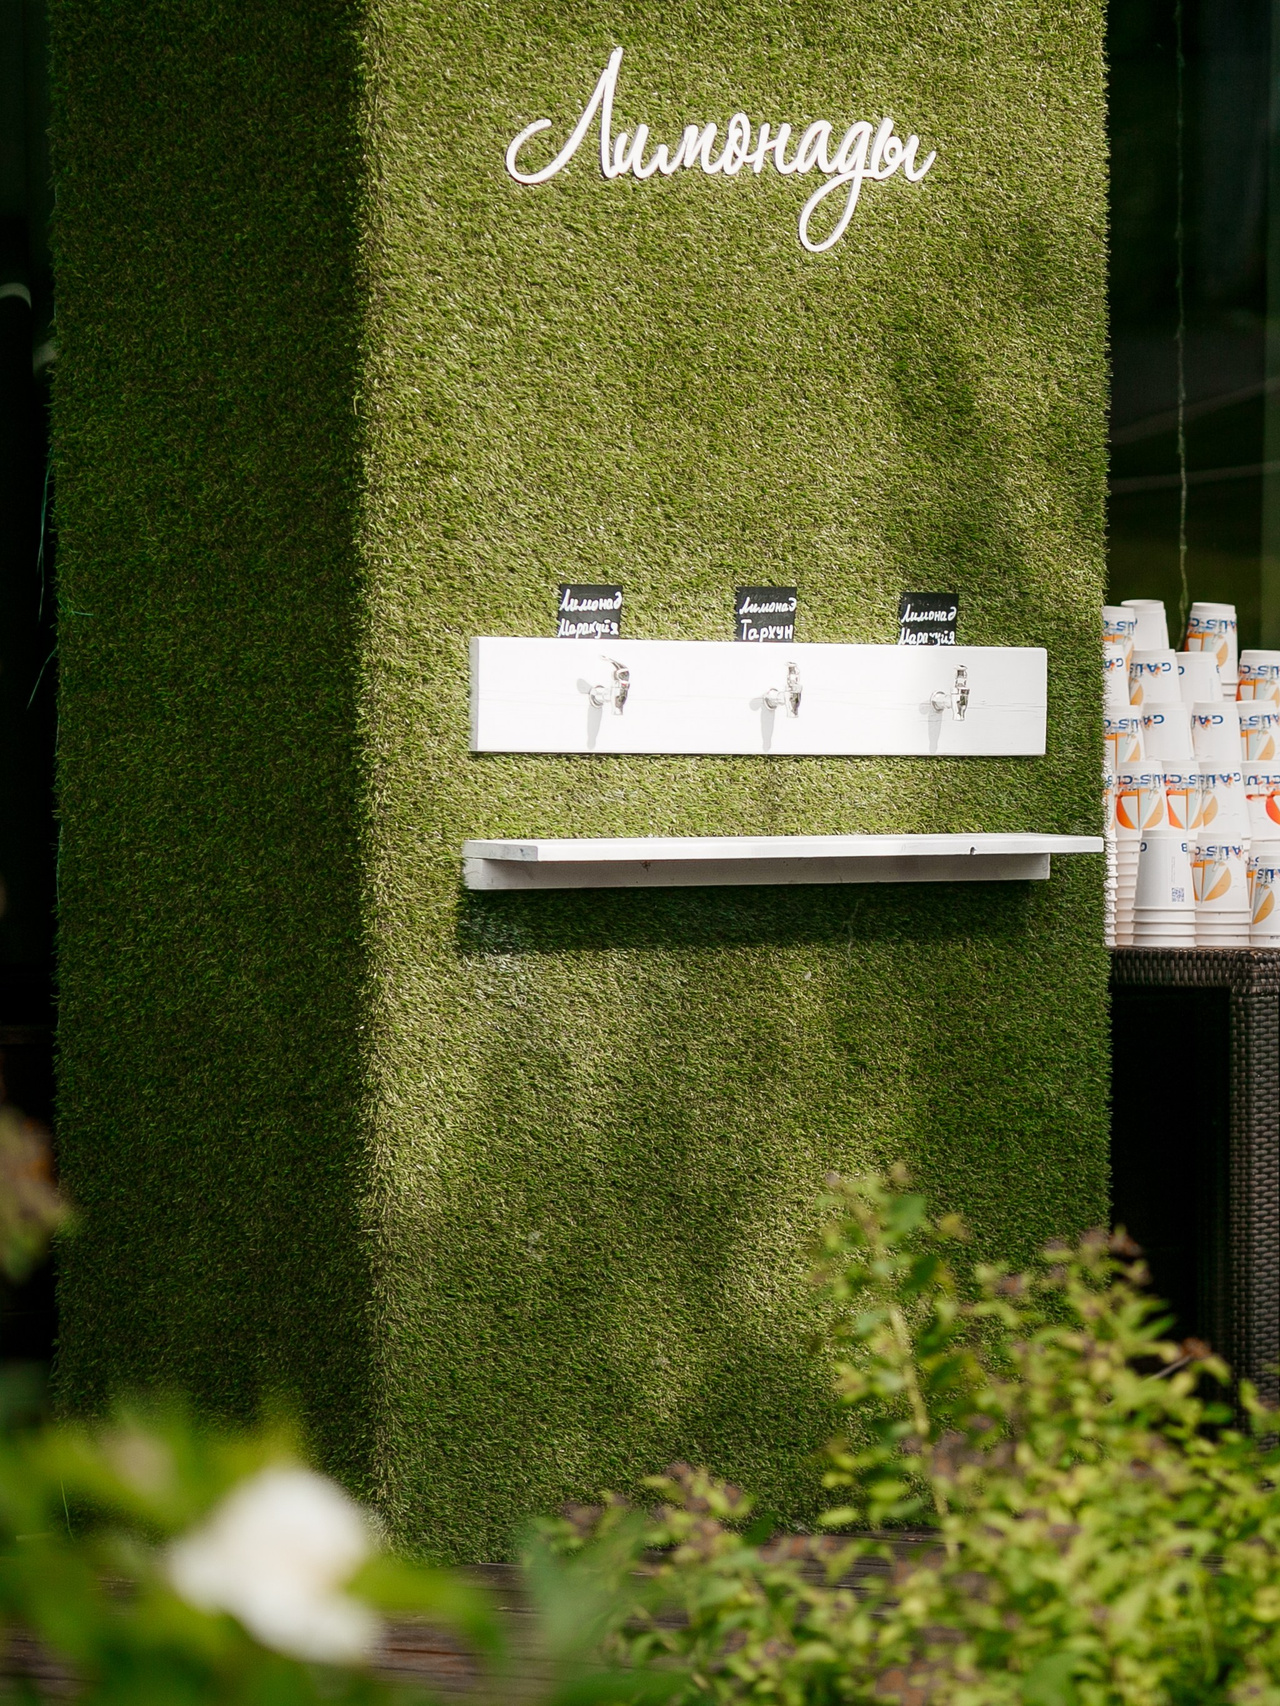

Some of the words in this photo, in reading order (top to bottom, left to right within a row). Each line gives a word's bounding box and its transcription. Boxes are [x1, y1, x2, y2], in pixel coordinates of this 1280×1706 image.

[504, 45, 938, 254] Лимонады
[558, 588, 623, 612] Лимонад
[739, 596, 797, 615] Лимонад
[901, 603, 957, 623] Лимонад
[557, 617, 619, 639] Маракуйя
[740, 618, 794, 643] Тархун
